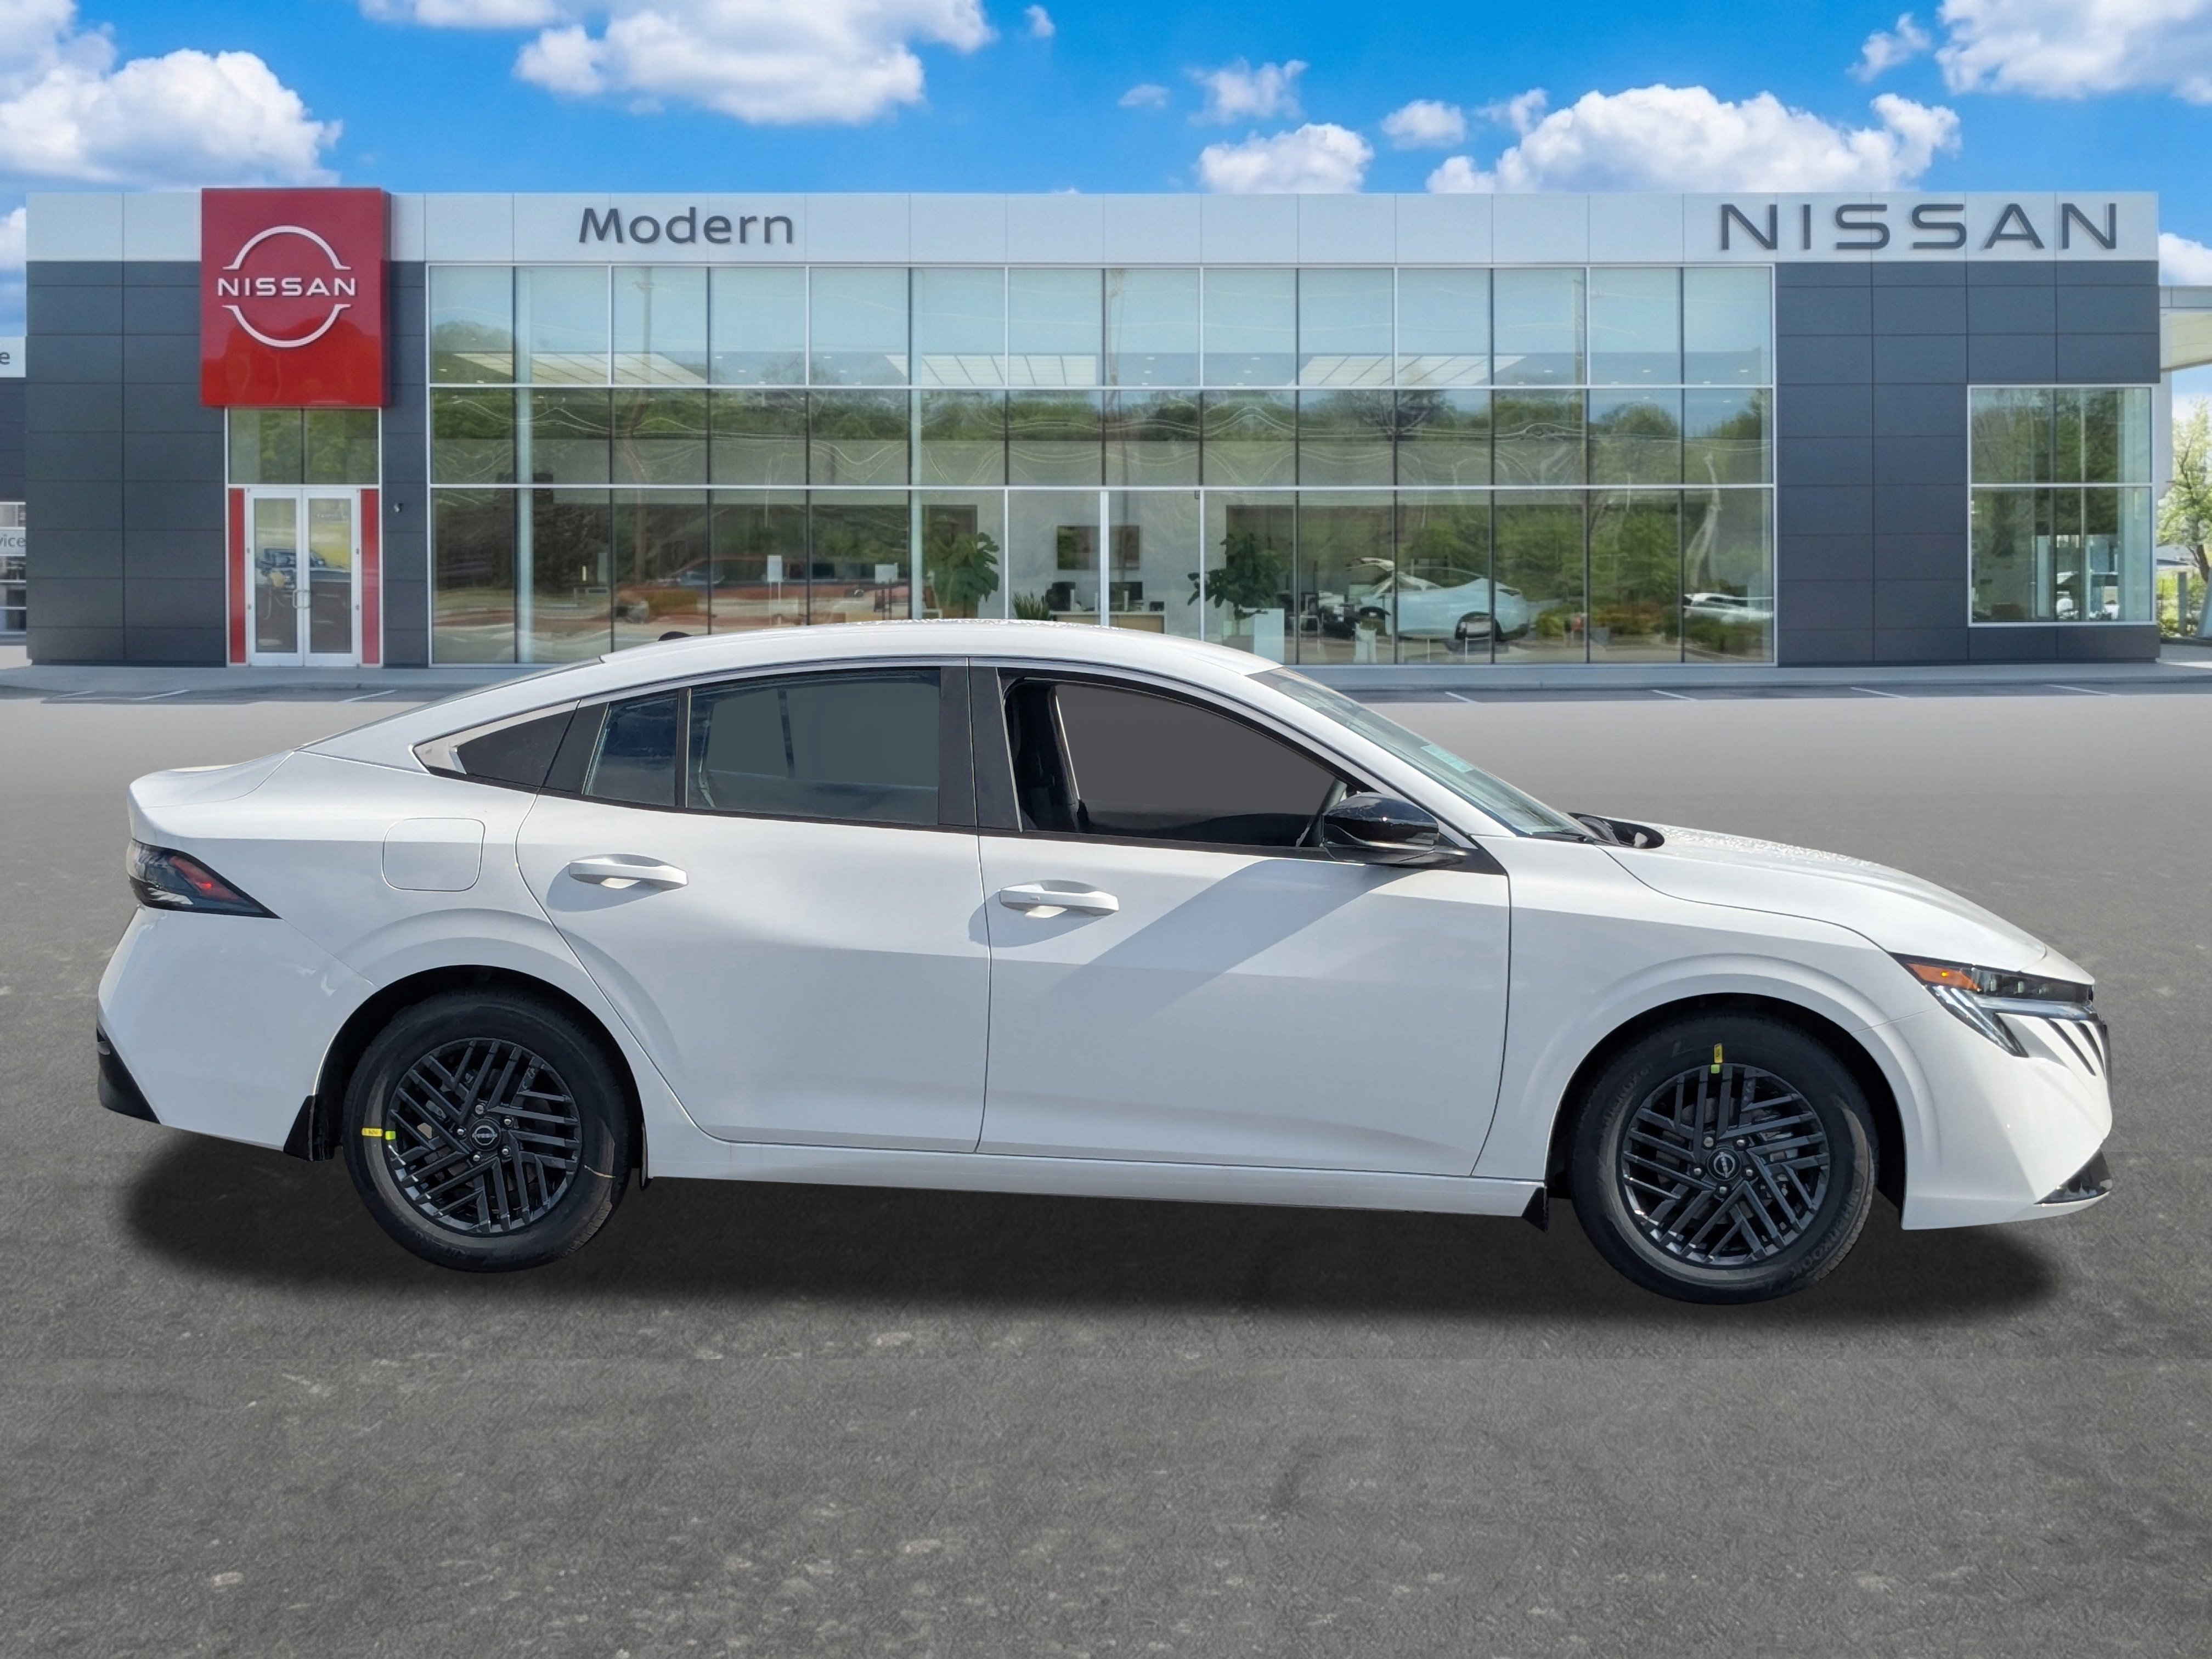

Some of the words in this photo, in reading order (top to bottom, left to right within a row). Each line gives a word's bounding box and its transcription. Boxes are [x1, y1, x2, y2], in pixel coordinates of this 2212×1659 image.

[579, 207, 793, 244] Modern
[1720, 203, 2117, 251] NISSAN
[218, 277, 356, 296] NISSAN
